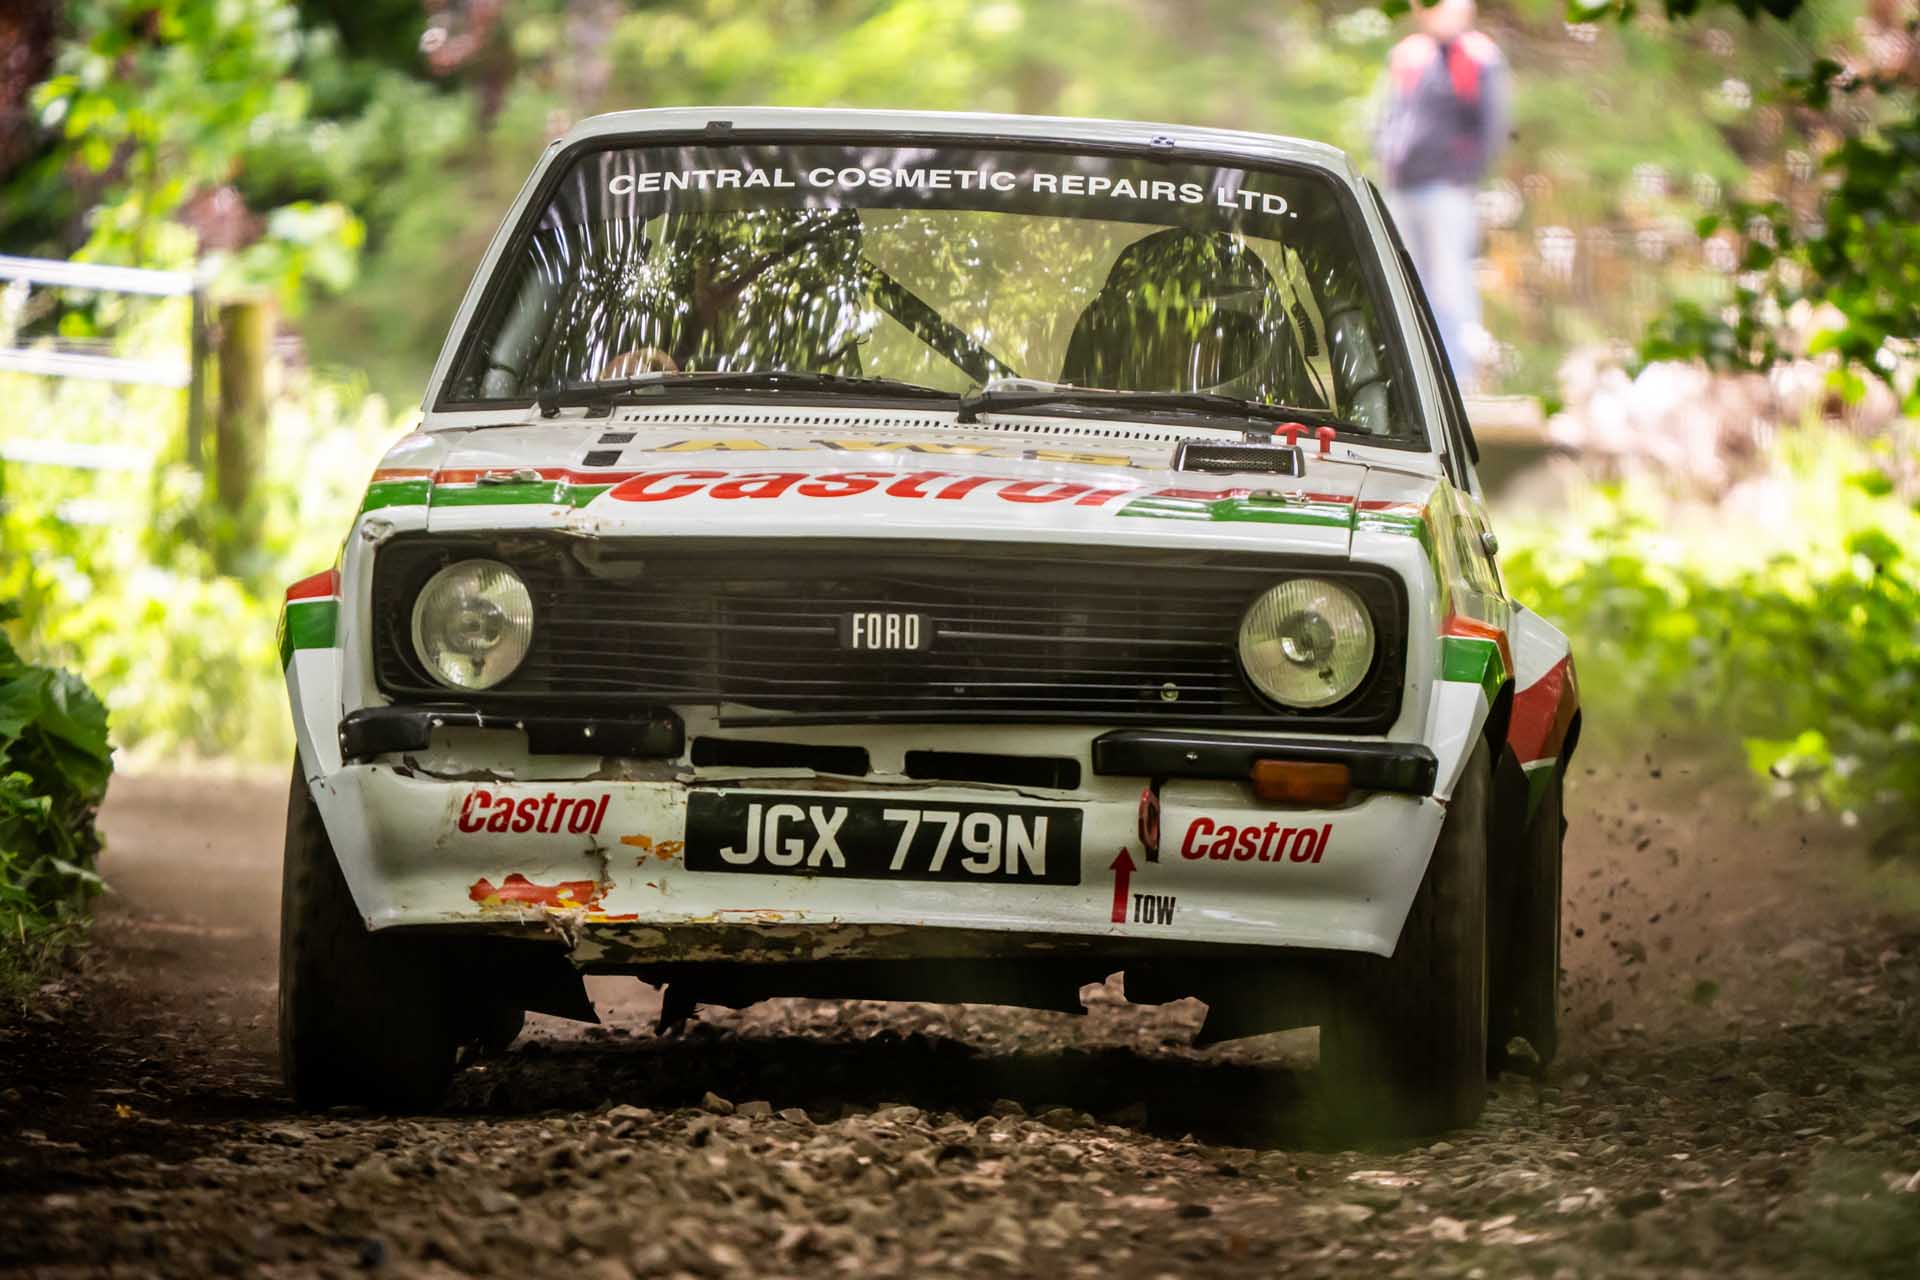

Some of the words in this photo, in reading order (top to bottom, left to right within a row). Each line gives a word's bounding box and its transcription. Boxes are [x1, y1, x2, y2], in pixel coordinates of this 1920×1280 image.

[608, 168, 795, 195] CENTRAL
[808, 167, 1017, 191] COSMETIC
[1032, 173, 1204, 204] REPAIRS
[1217, 187, 1298, 218] LTD.
[609, 470, 1135, 506] Castrol
[853, 613, 919, 649] FORD
[458, 790, 611, 834] Castrol
[719, 803, 849, 868] JGX
[883, 808, 1048, 876] 779N
[1181, 817, 1333, 863] Castrol
[1133, 894, 1176, 925] TOW
